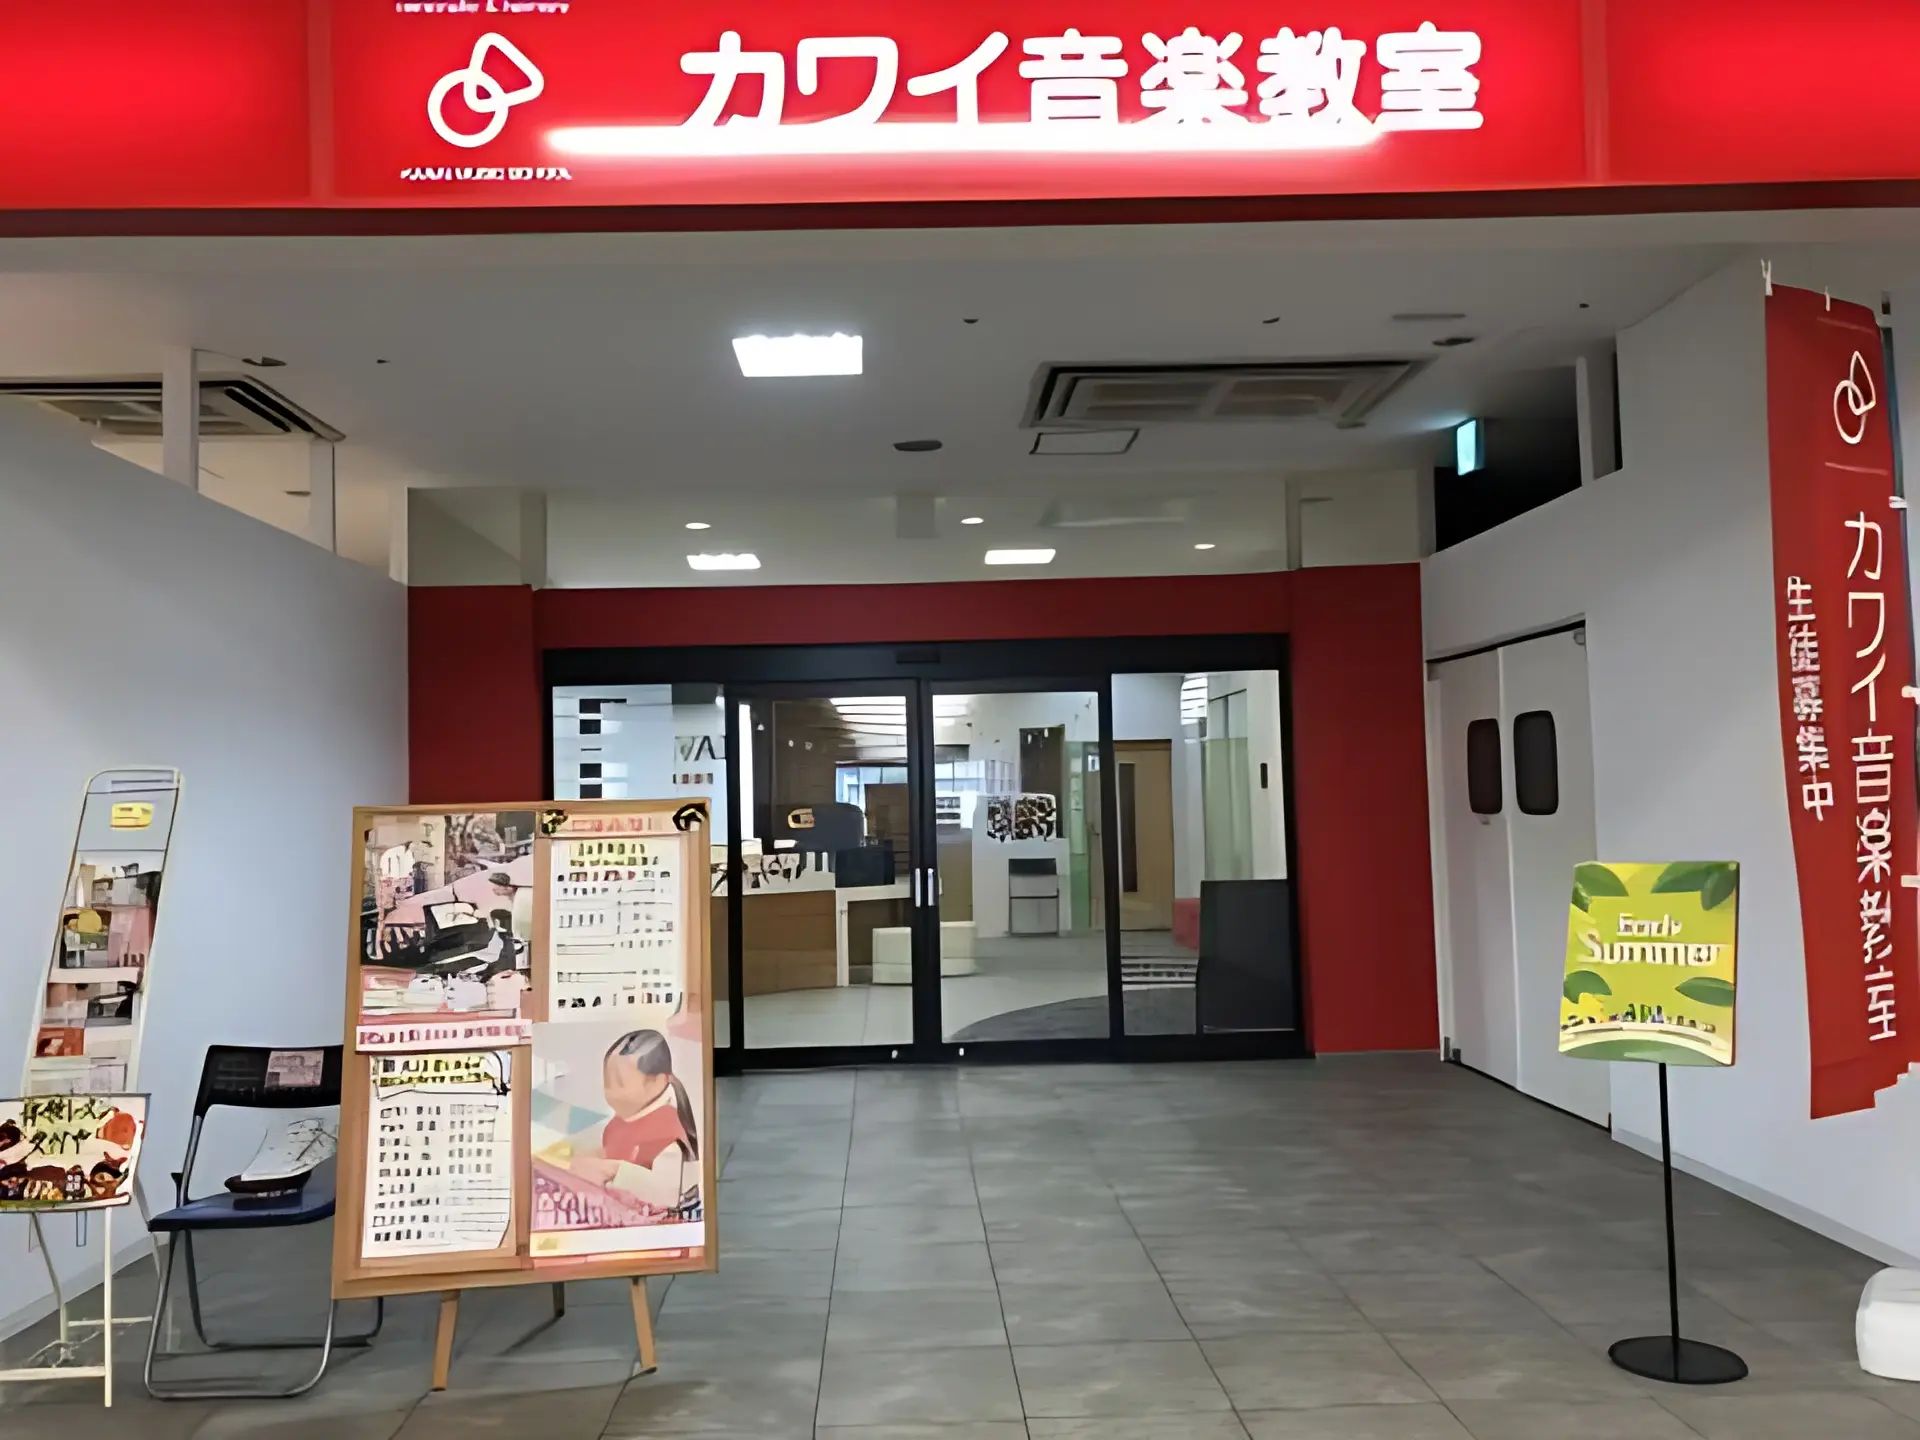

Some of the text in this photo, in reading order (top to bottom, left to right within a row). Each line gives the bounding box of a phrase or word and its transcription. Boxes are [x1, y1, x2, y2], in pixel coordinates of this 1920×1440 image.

[680, 21, 1484, 130] カワイ音楽教室
